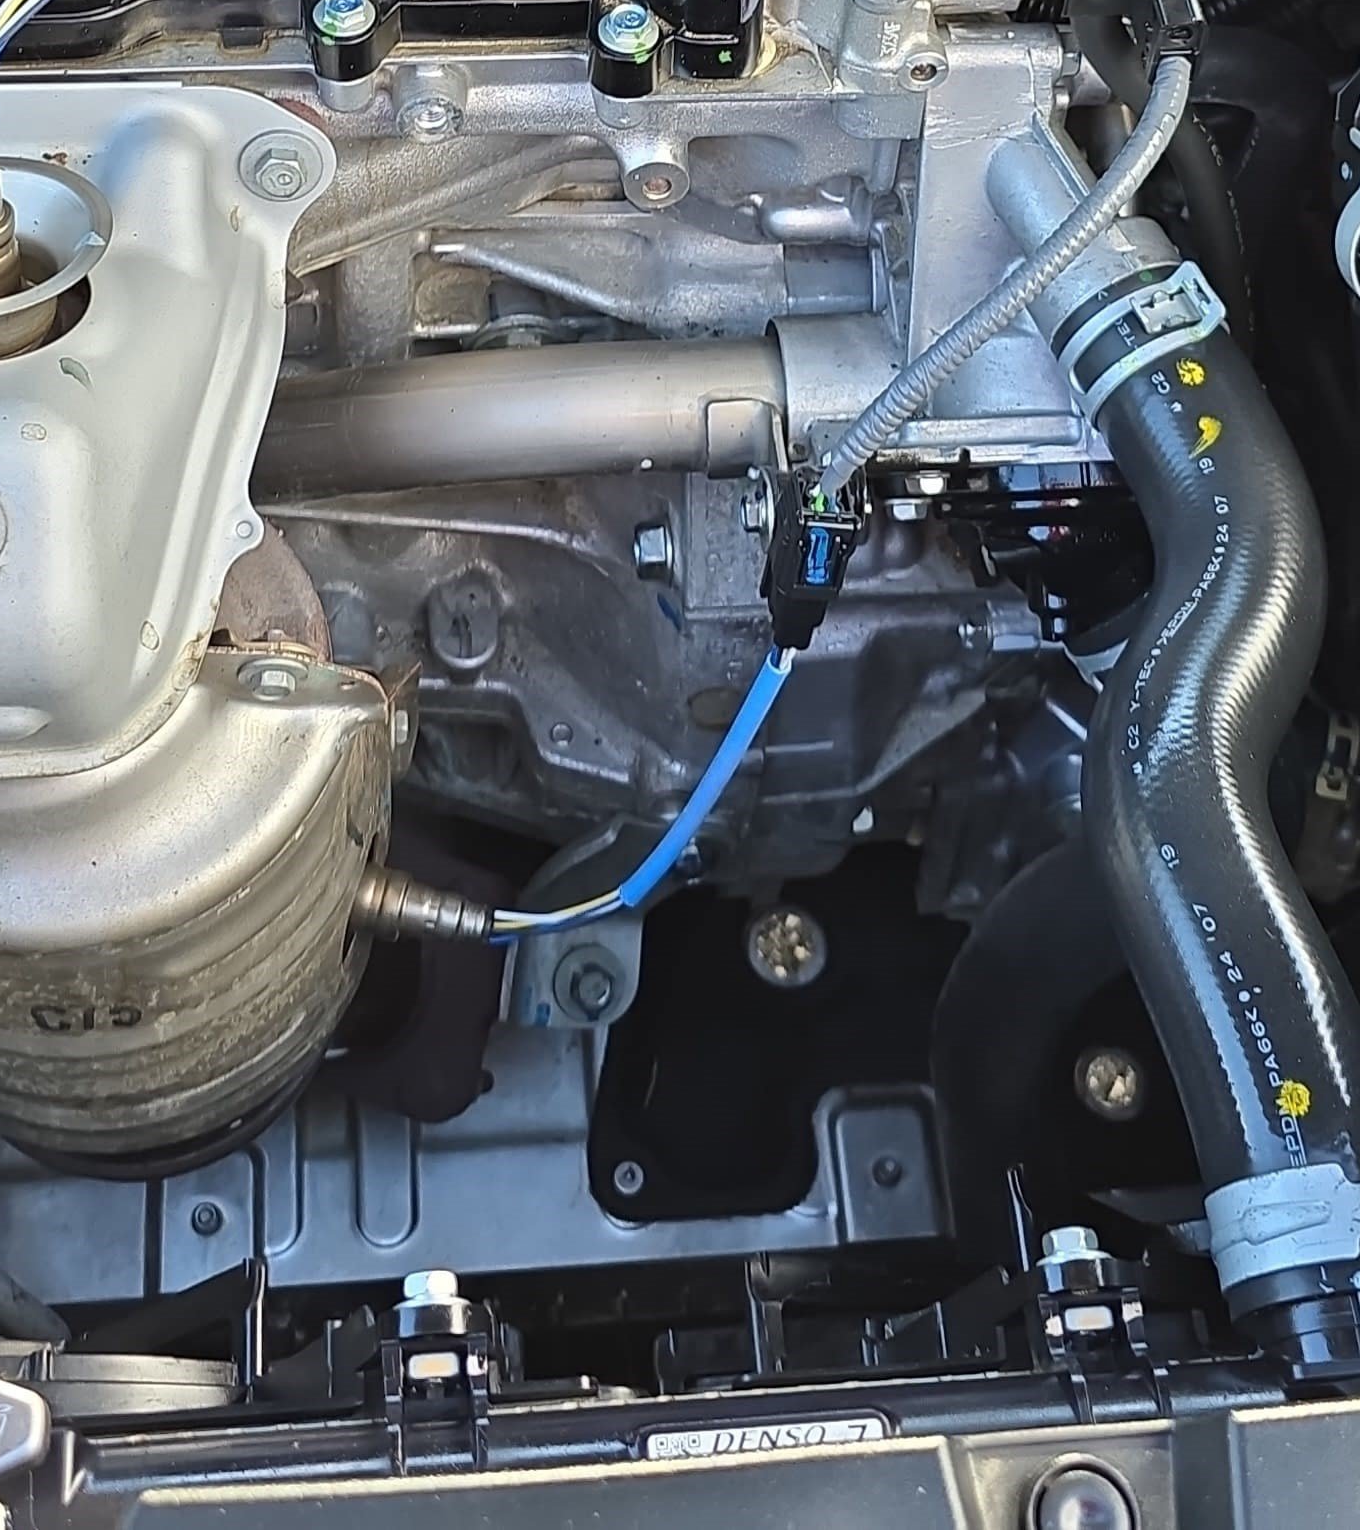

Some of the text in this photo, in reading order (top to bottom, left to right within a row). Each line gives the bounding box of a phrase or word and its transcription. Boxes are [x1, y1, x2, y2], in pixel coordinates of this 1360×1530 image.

[1149, 370, 1171, 396] C2
[1198, 456, 1216, 476] 19
[1214, 496, 1230, 515] 07
[1216, 523, 1230, 543] 24
[1128, 658, 1157, 712] Y-TEC
[1126, 723, 1141, 750] C2
[1160, 843, 1180, 869] 19
[1217, 949, 1244, 982] 24
[712, 1425, 826, 1454] DENSO
